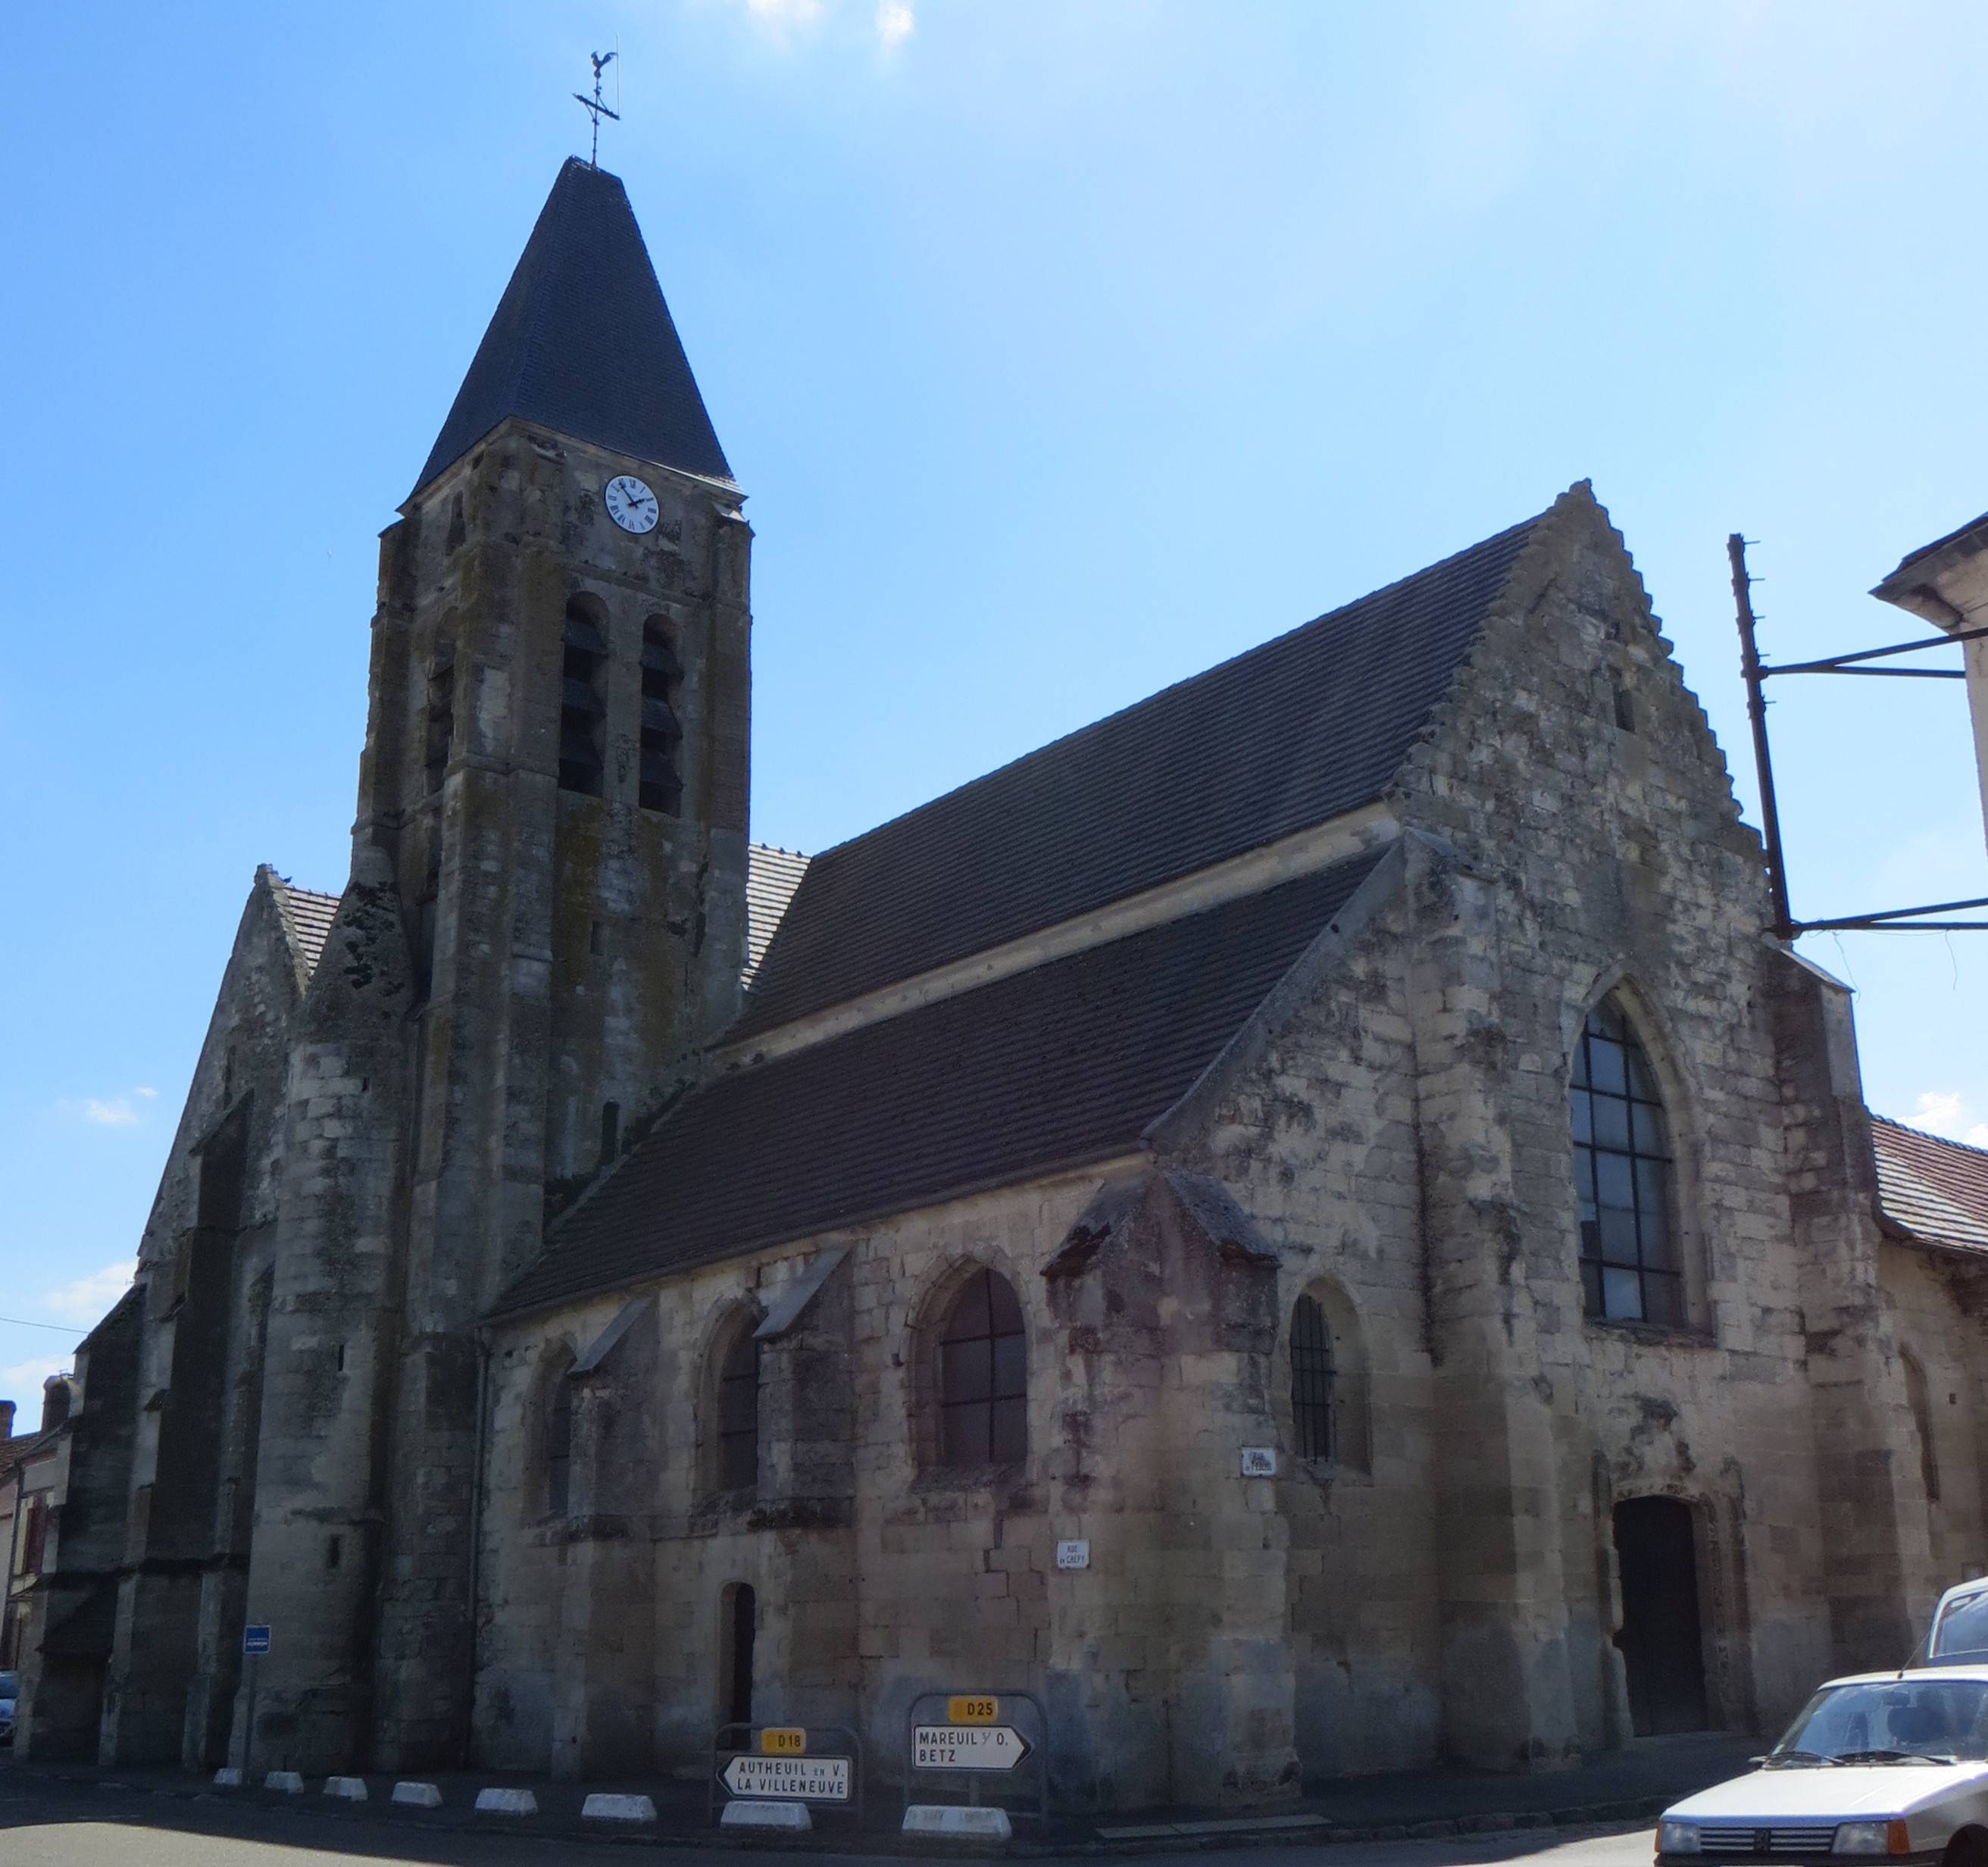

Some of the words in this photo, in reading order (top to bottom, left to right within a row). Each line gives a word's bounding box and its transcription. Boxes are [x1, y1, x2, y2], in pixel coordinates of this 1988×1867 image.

[967, 1703, 993, 1715] D25
[778, 1734, 801, 1747] D18
[919, 1732, 977, 1745] MAREUIL
[919, 1749, 956, 1762] BETZ
[739, 1762, 806, 1776] AUTHEUIL
[737, 1778, 752, 1790] LA
[759, 1778, 843, 1794] VILLENEUVE
